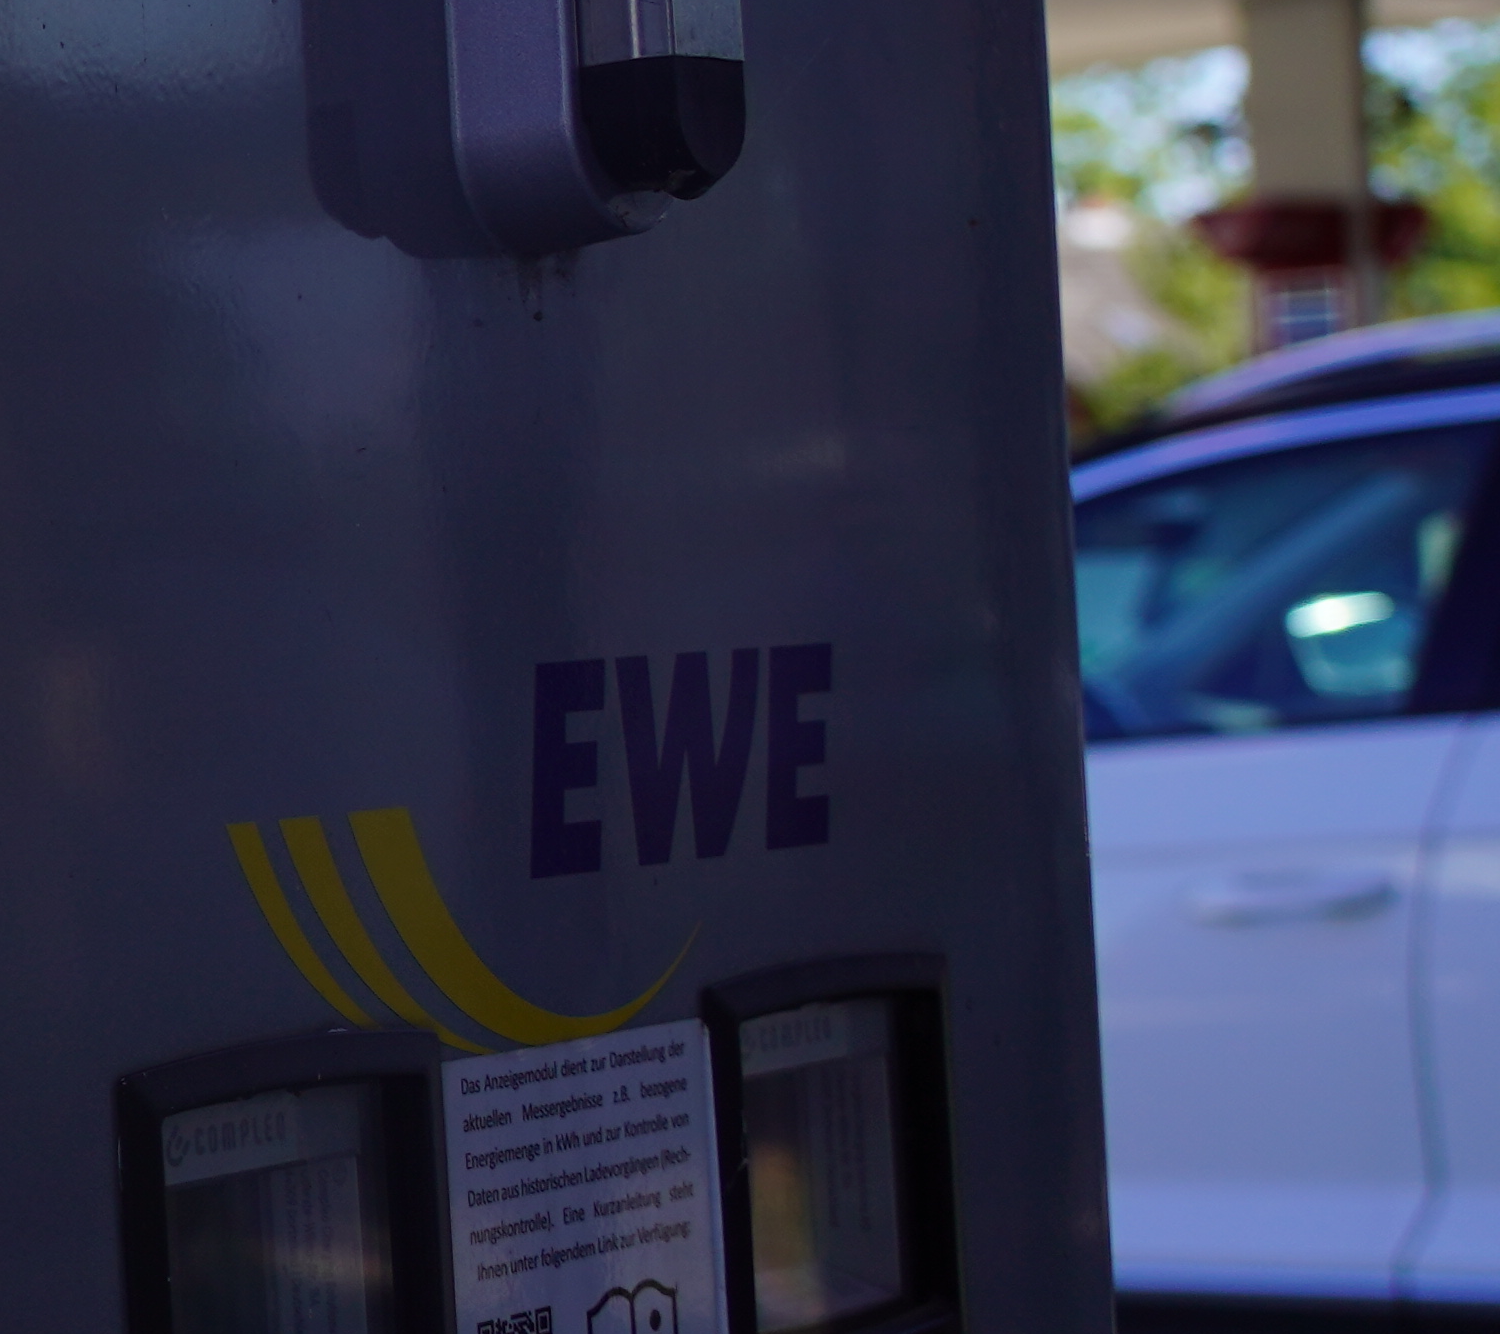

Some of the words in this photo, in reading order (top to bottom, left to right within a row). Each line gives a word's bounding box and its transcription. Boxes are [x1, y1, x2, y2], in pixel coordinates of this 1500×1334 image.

[529, 642, 832, 880] EWE
[461, 1078, 480, 1095] Das
[484, 1061, 557, 1091] Anzeigemodul
[561, 1058, 588, 1077] dient
[591, 1057, 606, 1072] zur
[610, 1045, 666, 1068] Darstellung
[668, 1041, 684, 1057] der
[463, 1109, 512, 1133] aktuellen
[522, 1093, 603, 1121] Messergebnisse
[613, 1085, 630, 1104] z.B.
[640, 1078, 687, 1099] bezogene
[465, 1143, 540, 1170] Energiemenge
[543, 1138, 553, 1154] in
[556, 1131, 580, 1151] kWh
[583, 1127, 603, 1147] und
[606, 1127, 621, 1142] zur
[624, 1114, 668, 1137] Kontrolle
[671, 1113, 689, 1128] von
[468, 1189, 499, 1208] Daten
[502, 1185, 520, 1201] aus
[521, 1170, 583, 1196] historischen
[584, 1155, 659, 1183] Ladevorgängen
[661, 1146, 690, 1170] (Rech-
[470, 1211, 554, 1245] nungskontrolle).
[563, 1207, 585, 1225] Eine
[594, 1192, 661, 1217] Kurzanleitung
[670, 1182, 694, 1201] steht
[478, 1263, 508, 1281] Ihnen
[510, 1255, 539, 1275] unter
[541, 1242, 596, 1269] folgendem
[598, 1233, 619, 1254] Link
[620, 1233, 635, 1249] zur
